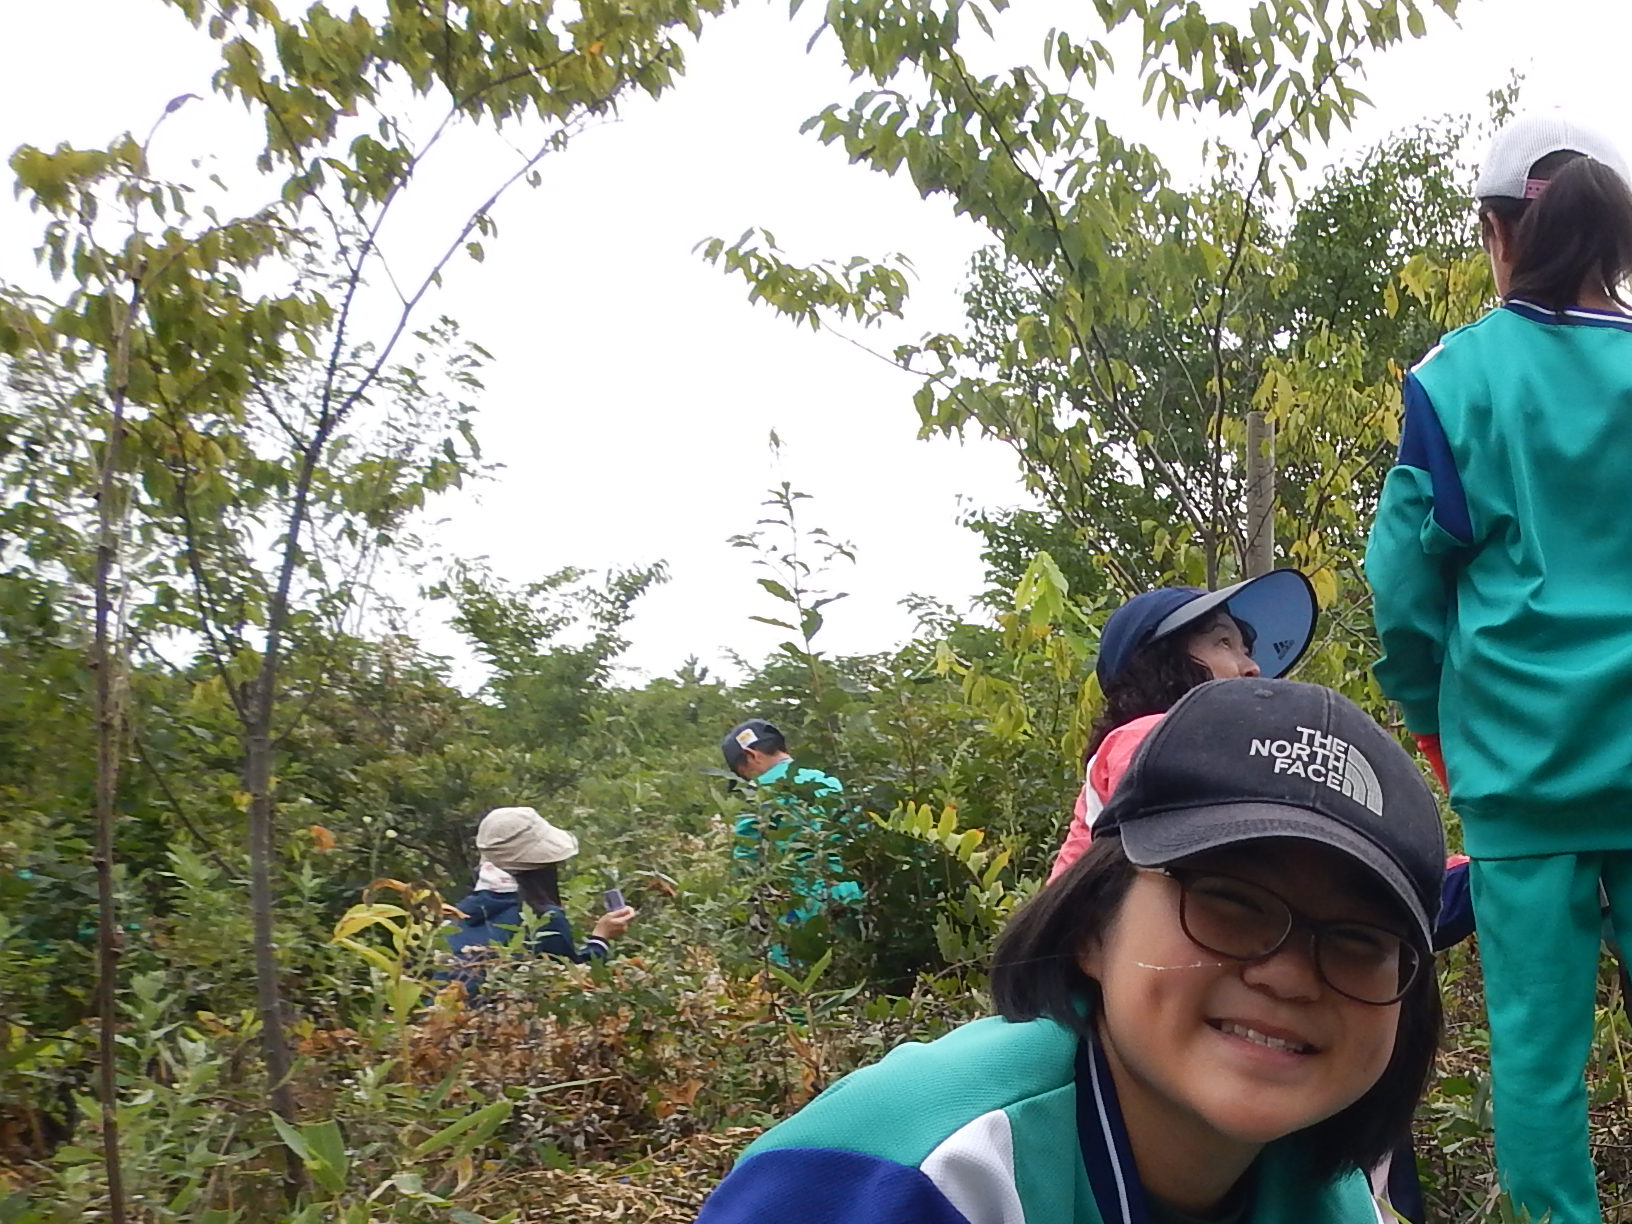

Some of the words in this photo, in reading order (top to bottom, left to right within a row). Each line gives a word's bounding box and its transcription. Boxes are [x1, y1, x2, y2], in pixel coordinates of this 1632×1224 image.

[1249, 739, 1346, 775] NORTH
[1296, 726, 1348, 755] THE
[1274, 758, 1343, 791] FACE
